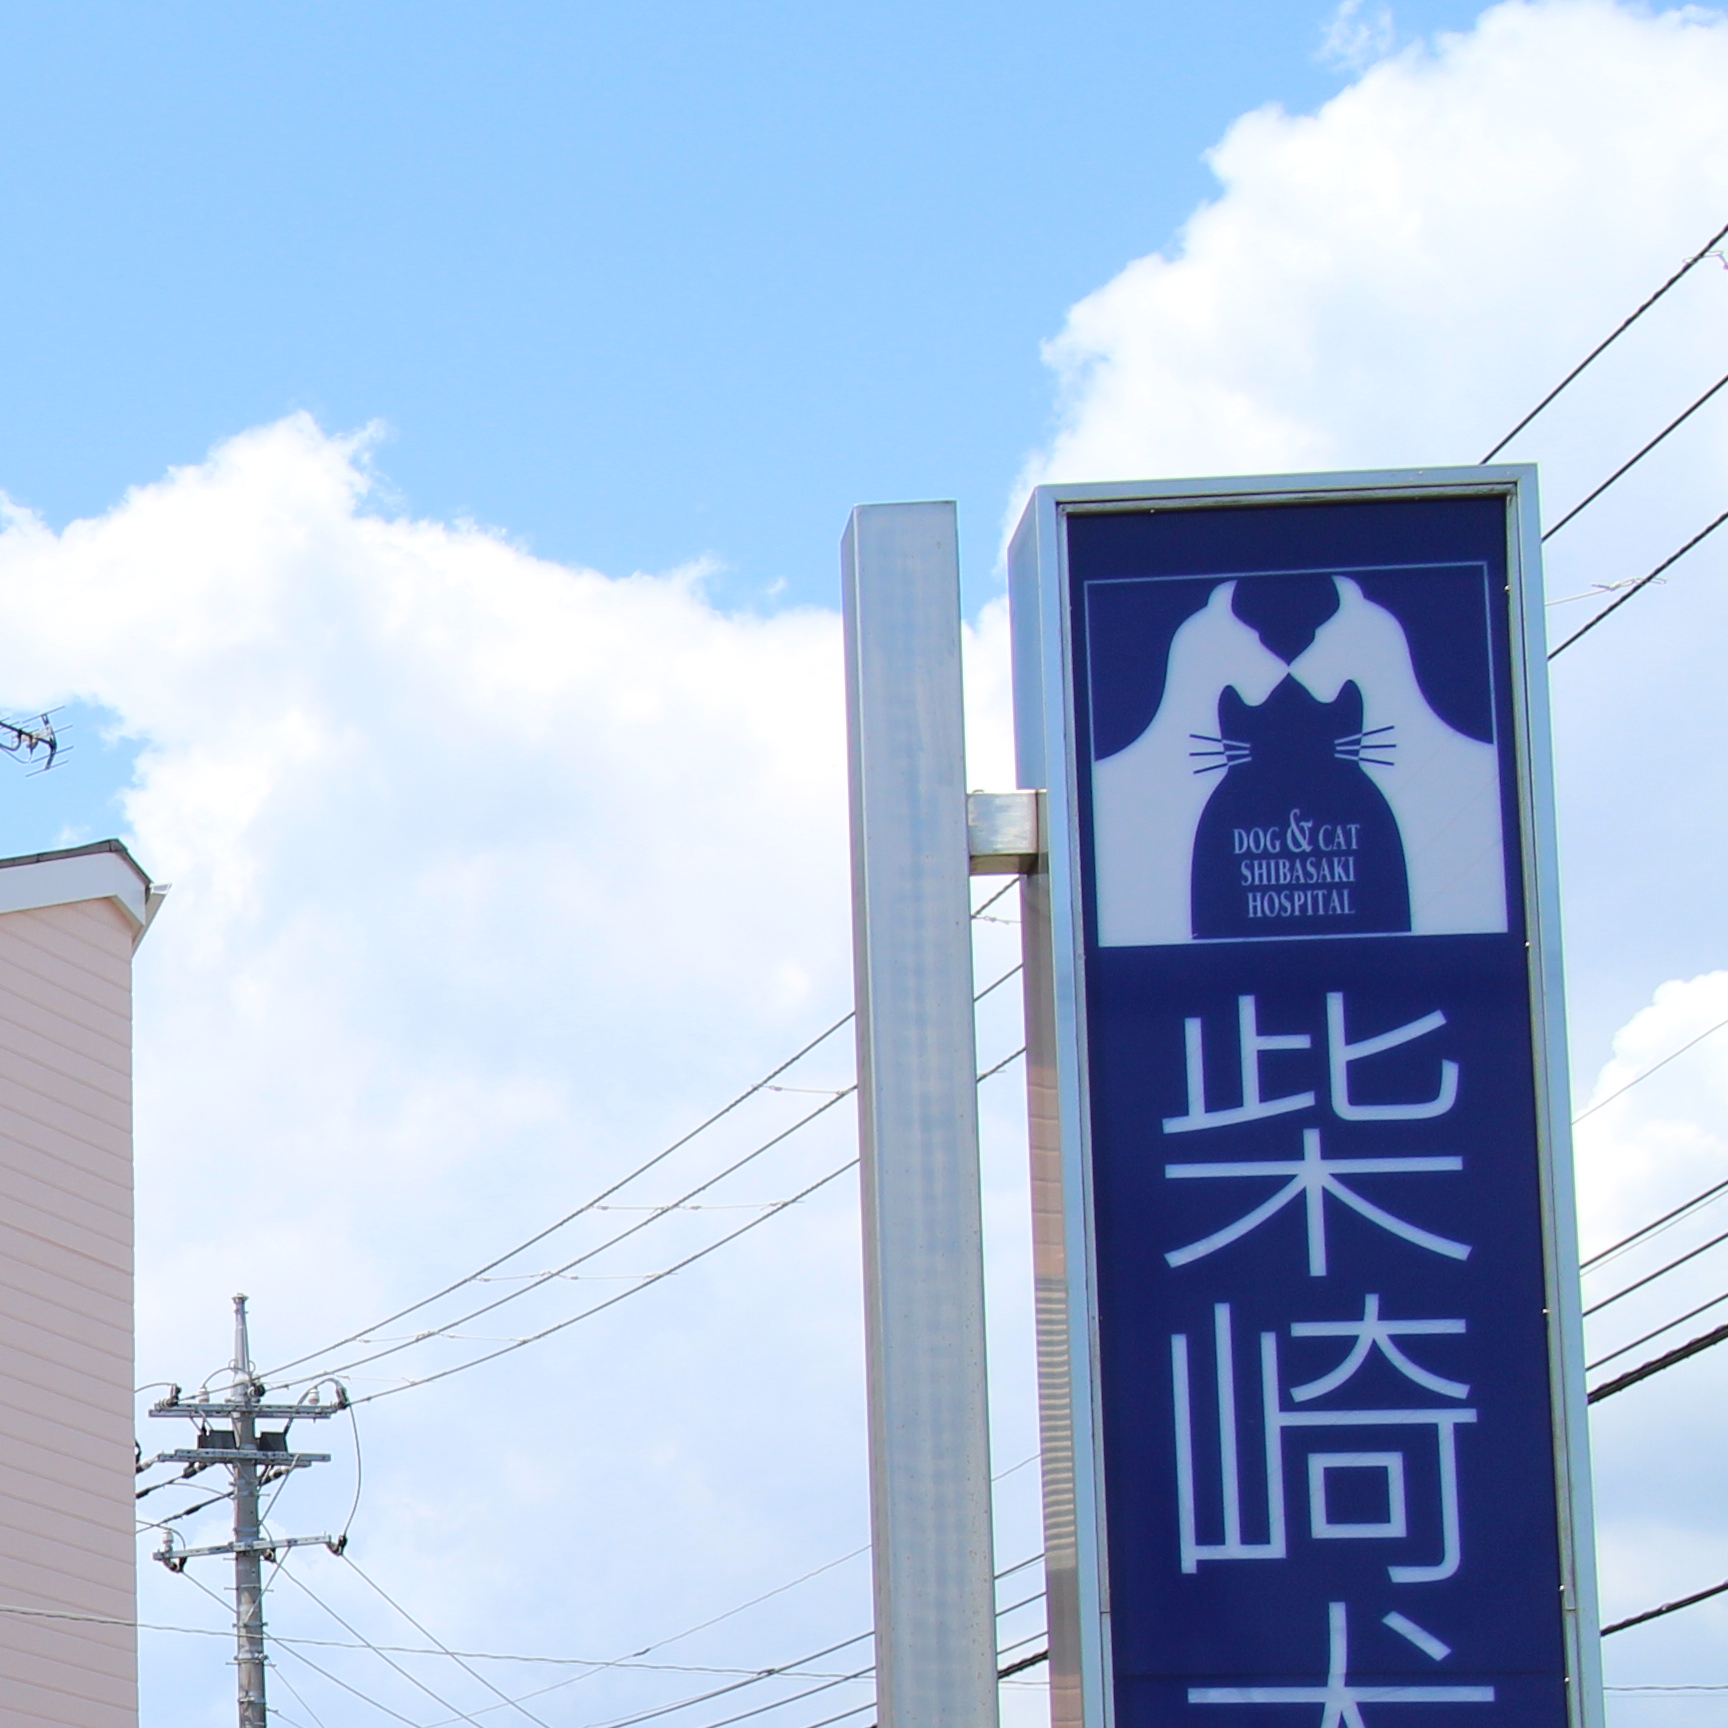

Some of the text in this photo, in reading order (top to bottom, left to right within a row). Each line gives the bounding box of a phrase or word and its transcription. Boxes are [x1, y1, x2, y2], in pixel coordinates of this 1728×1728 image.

[1234, 808, 1360, 855] DOG & CAT
[1241, 856, 1355, 886] SHIBASAKI
[1247, 888, 1355, 918] HOSPITAL
